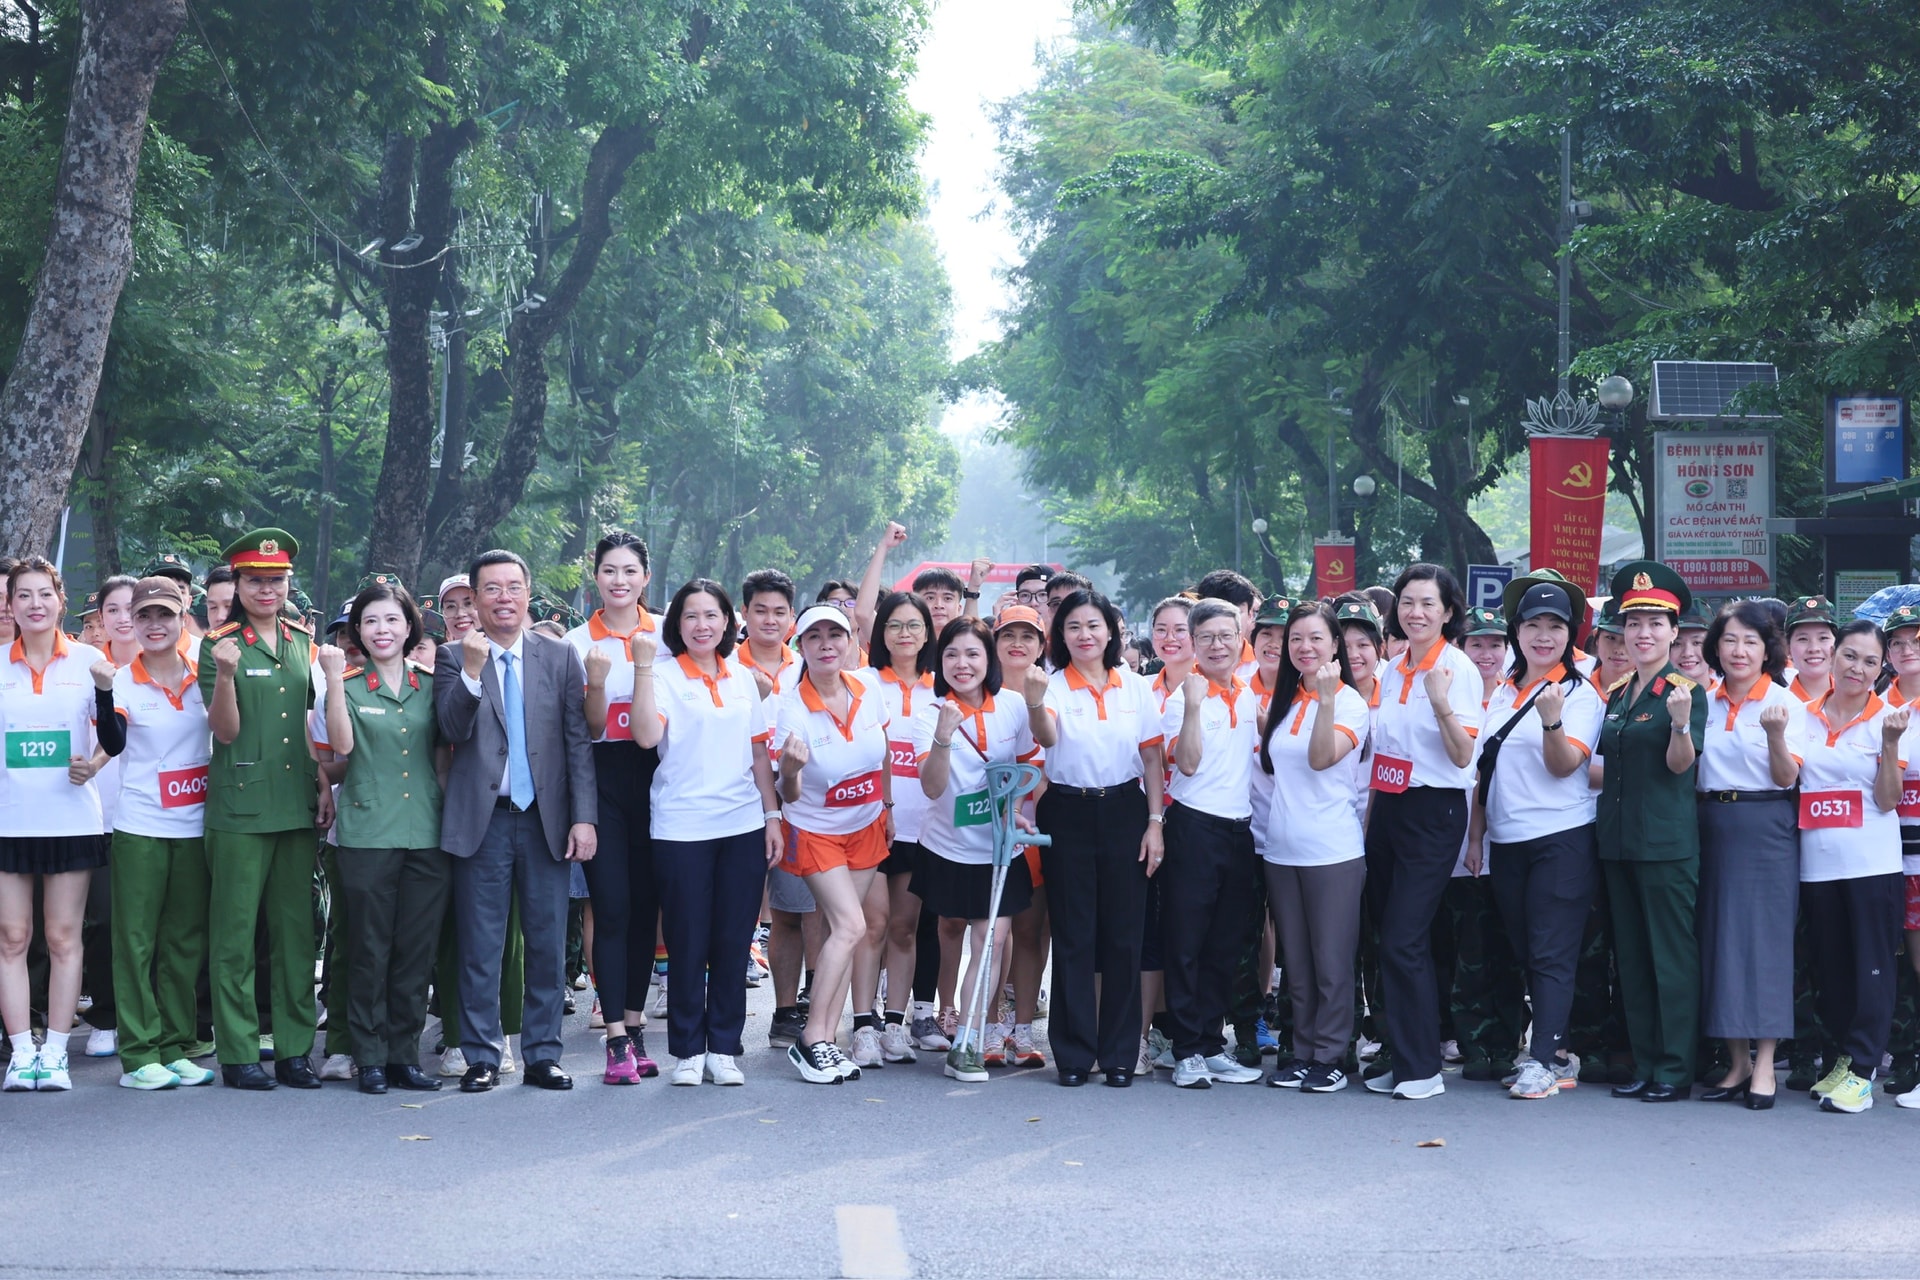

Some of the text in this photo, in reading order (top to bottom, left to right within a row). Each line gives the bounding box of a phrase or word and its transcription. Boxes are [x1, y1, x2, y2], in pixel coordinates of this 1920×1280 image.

[1667, 441, 1764, 458] BỆNH VIỆN MẮT
[1723, 464, 1754, 477] SƠN
[1705, 502, 1726, 513] CẬN
[1728, 503, 1745, 513] THỊ
[1670, 515, 1690, 526] CÁC
[1692, 516, 1723, 528] BỆNH
[1739, 514, 1763, 525] MẮT
[1562, 525, 1577, 536] MỤC
[1682, 529, 1694, 538] VÀ
[1695, 529, 1708, 538] KẾT
[1709, 529, 1726, 539] QUẢ
[1728, 529, 1742, 538] TỐT
[1743, 528, 1764, 538] NHẤT
[1683, 561, 1709, 573] 0904
[1711, 561, 1729, 573] 088
[1731, 561, 1750, 572] 899
[1693, 574, 1709, 585] GIẢI
[1709, 574, 1734, 585] PHÓNG
[1739, 574, 1749, 585] HÀ
[1751, 575, 1763, 586] NỘI
[1476, 577, 1504, 607] P
[19, 741, 57, 757] 1219
[1377, 764, 1404, 786] 0608
[168, 775, 208, 797] 0409
[835, 779, 875, 801] 0533
[1810, 800, 1851, 818] 0531
